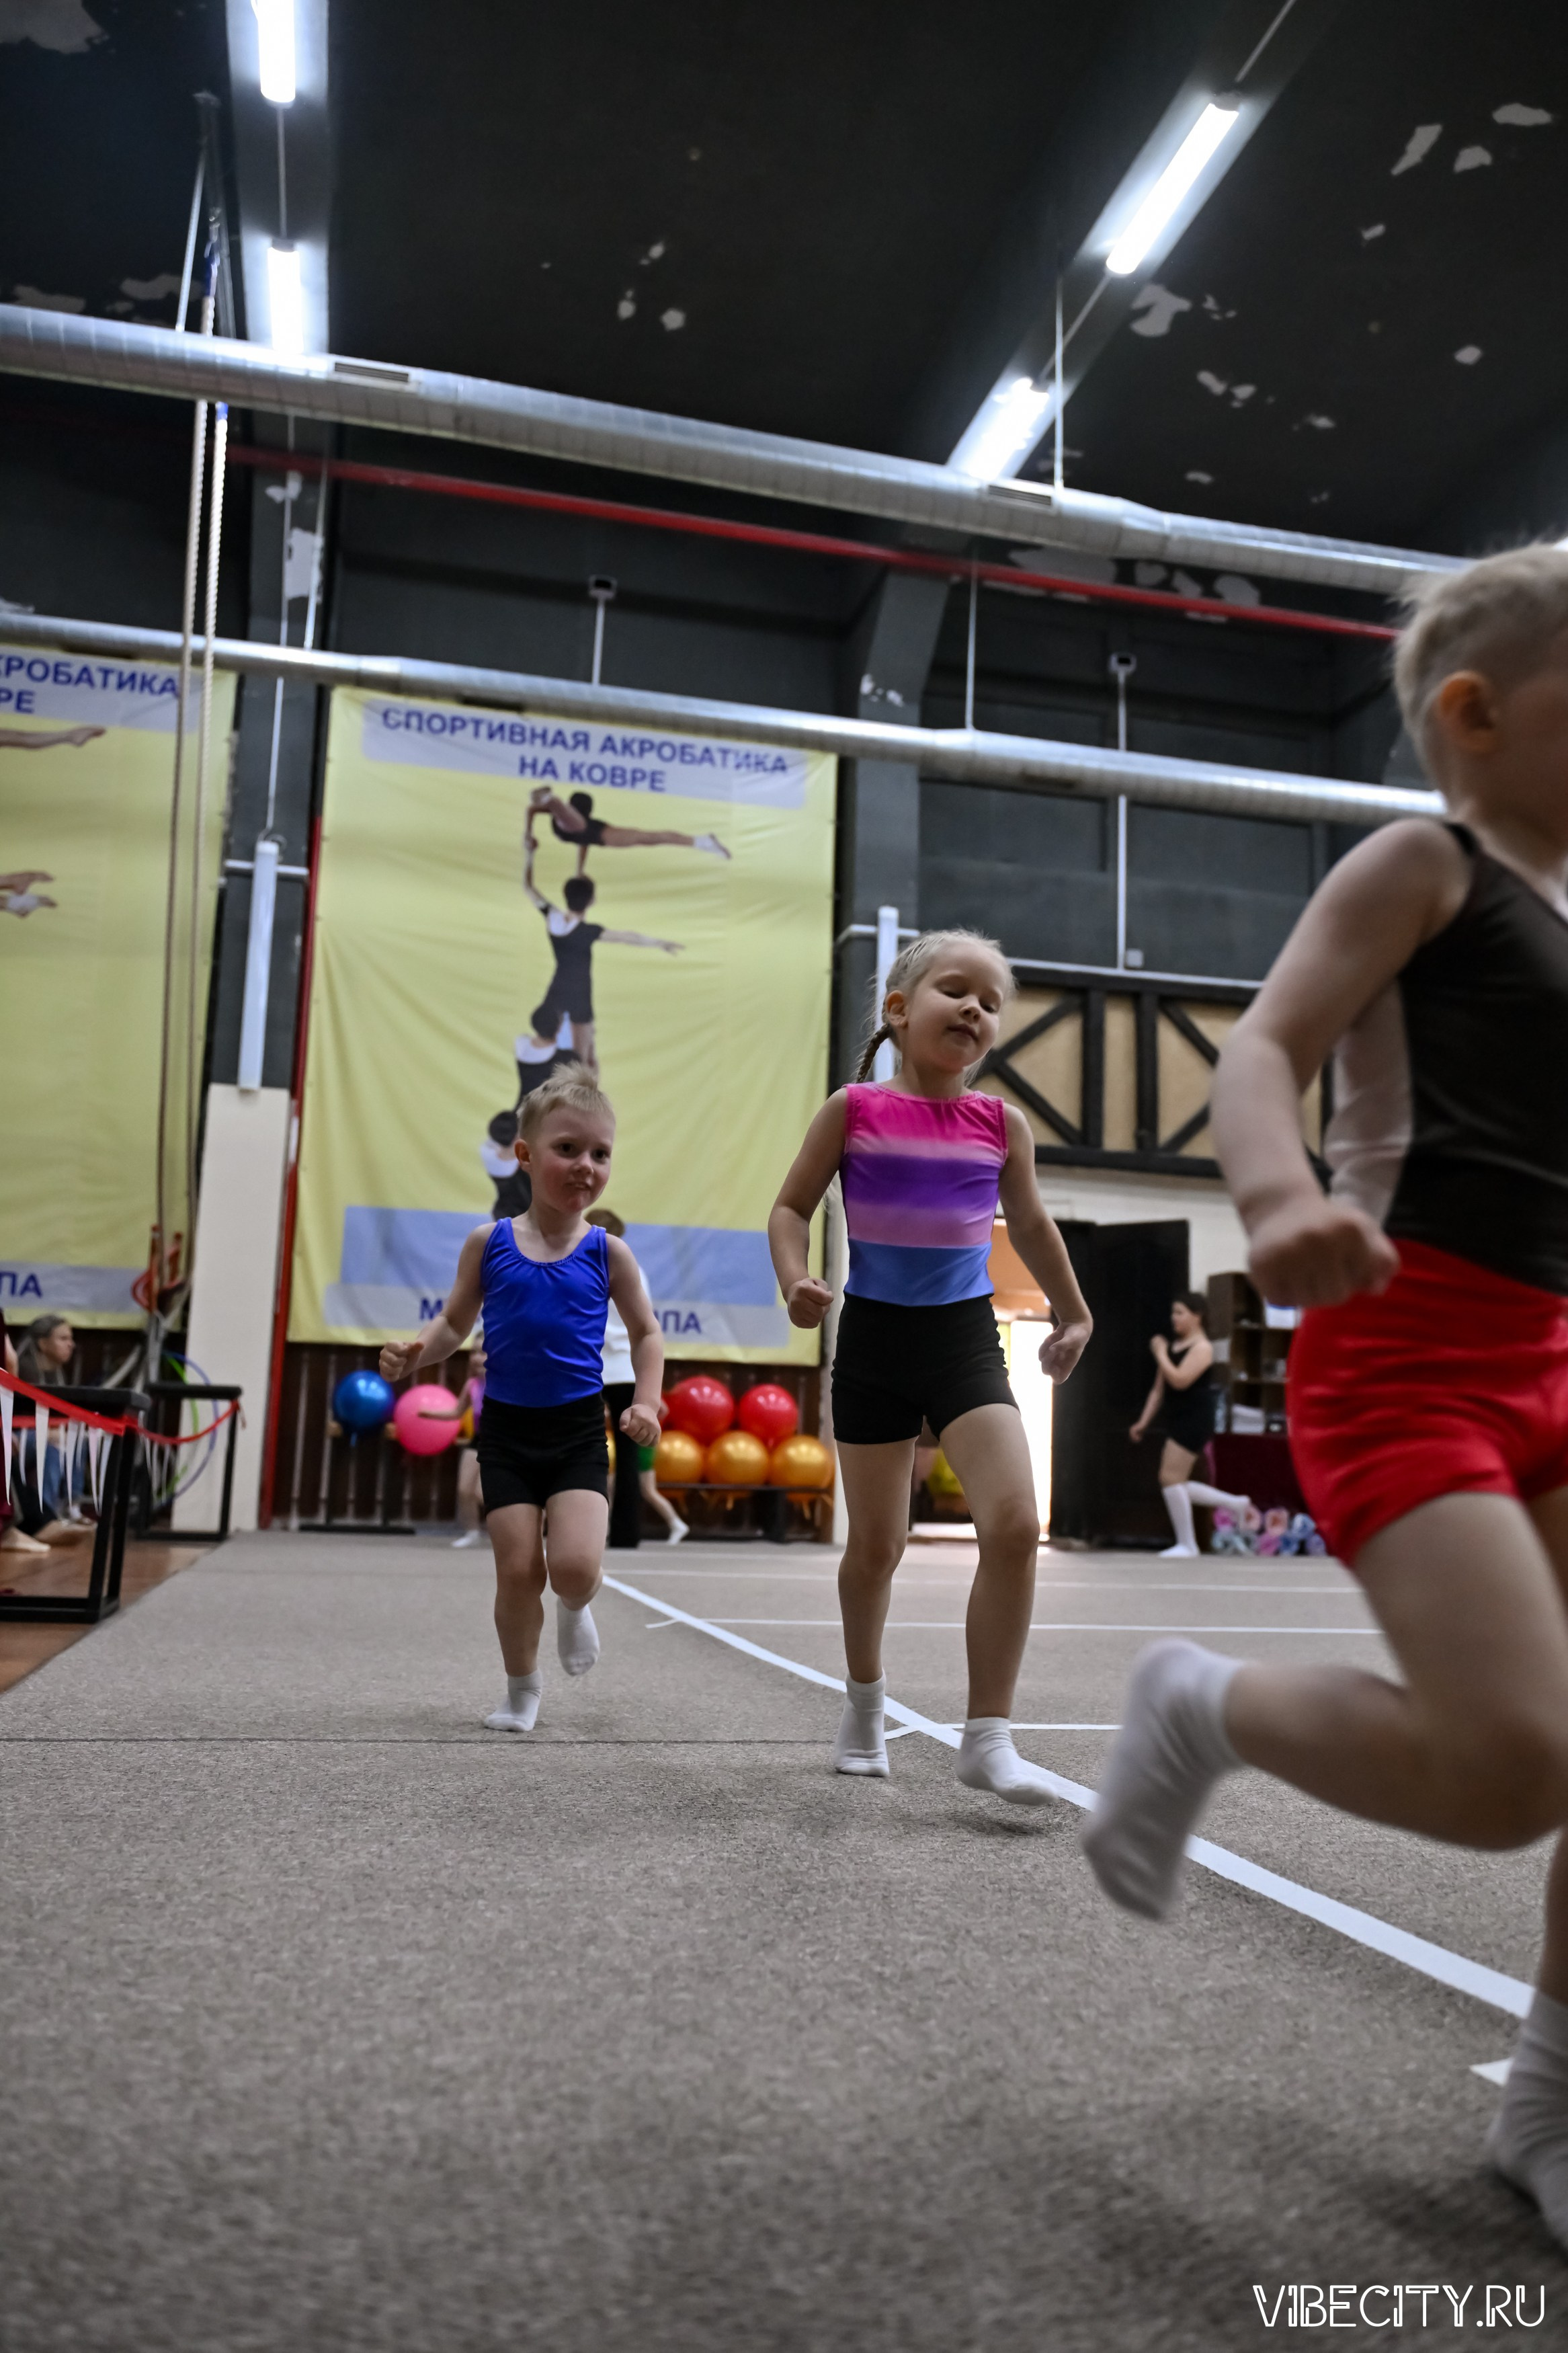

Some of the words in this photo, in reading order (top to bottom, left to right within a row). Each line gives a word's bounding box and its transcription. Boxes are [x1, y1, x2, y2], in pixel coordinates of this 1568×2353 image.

[0, 654, 180, 698] РОБАТИКА
[382, 708, 589, 752] СПОРТИВНАЯ
[600, 734, 787, 772] АКРОБАТИКА
[519, 755, 559, 779] НА
[569, 761, 667, 792] КОВРЕ
